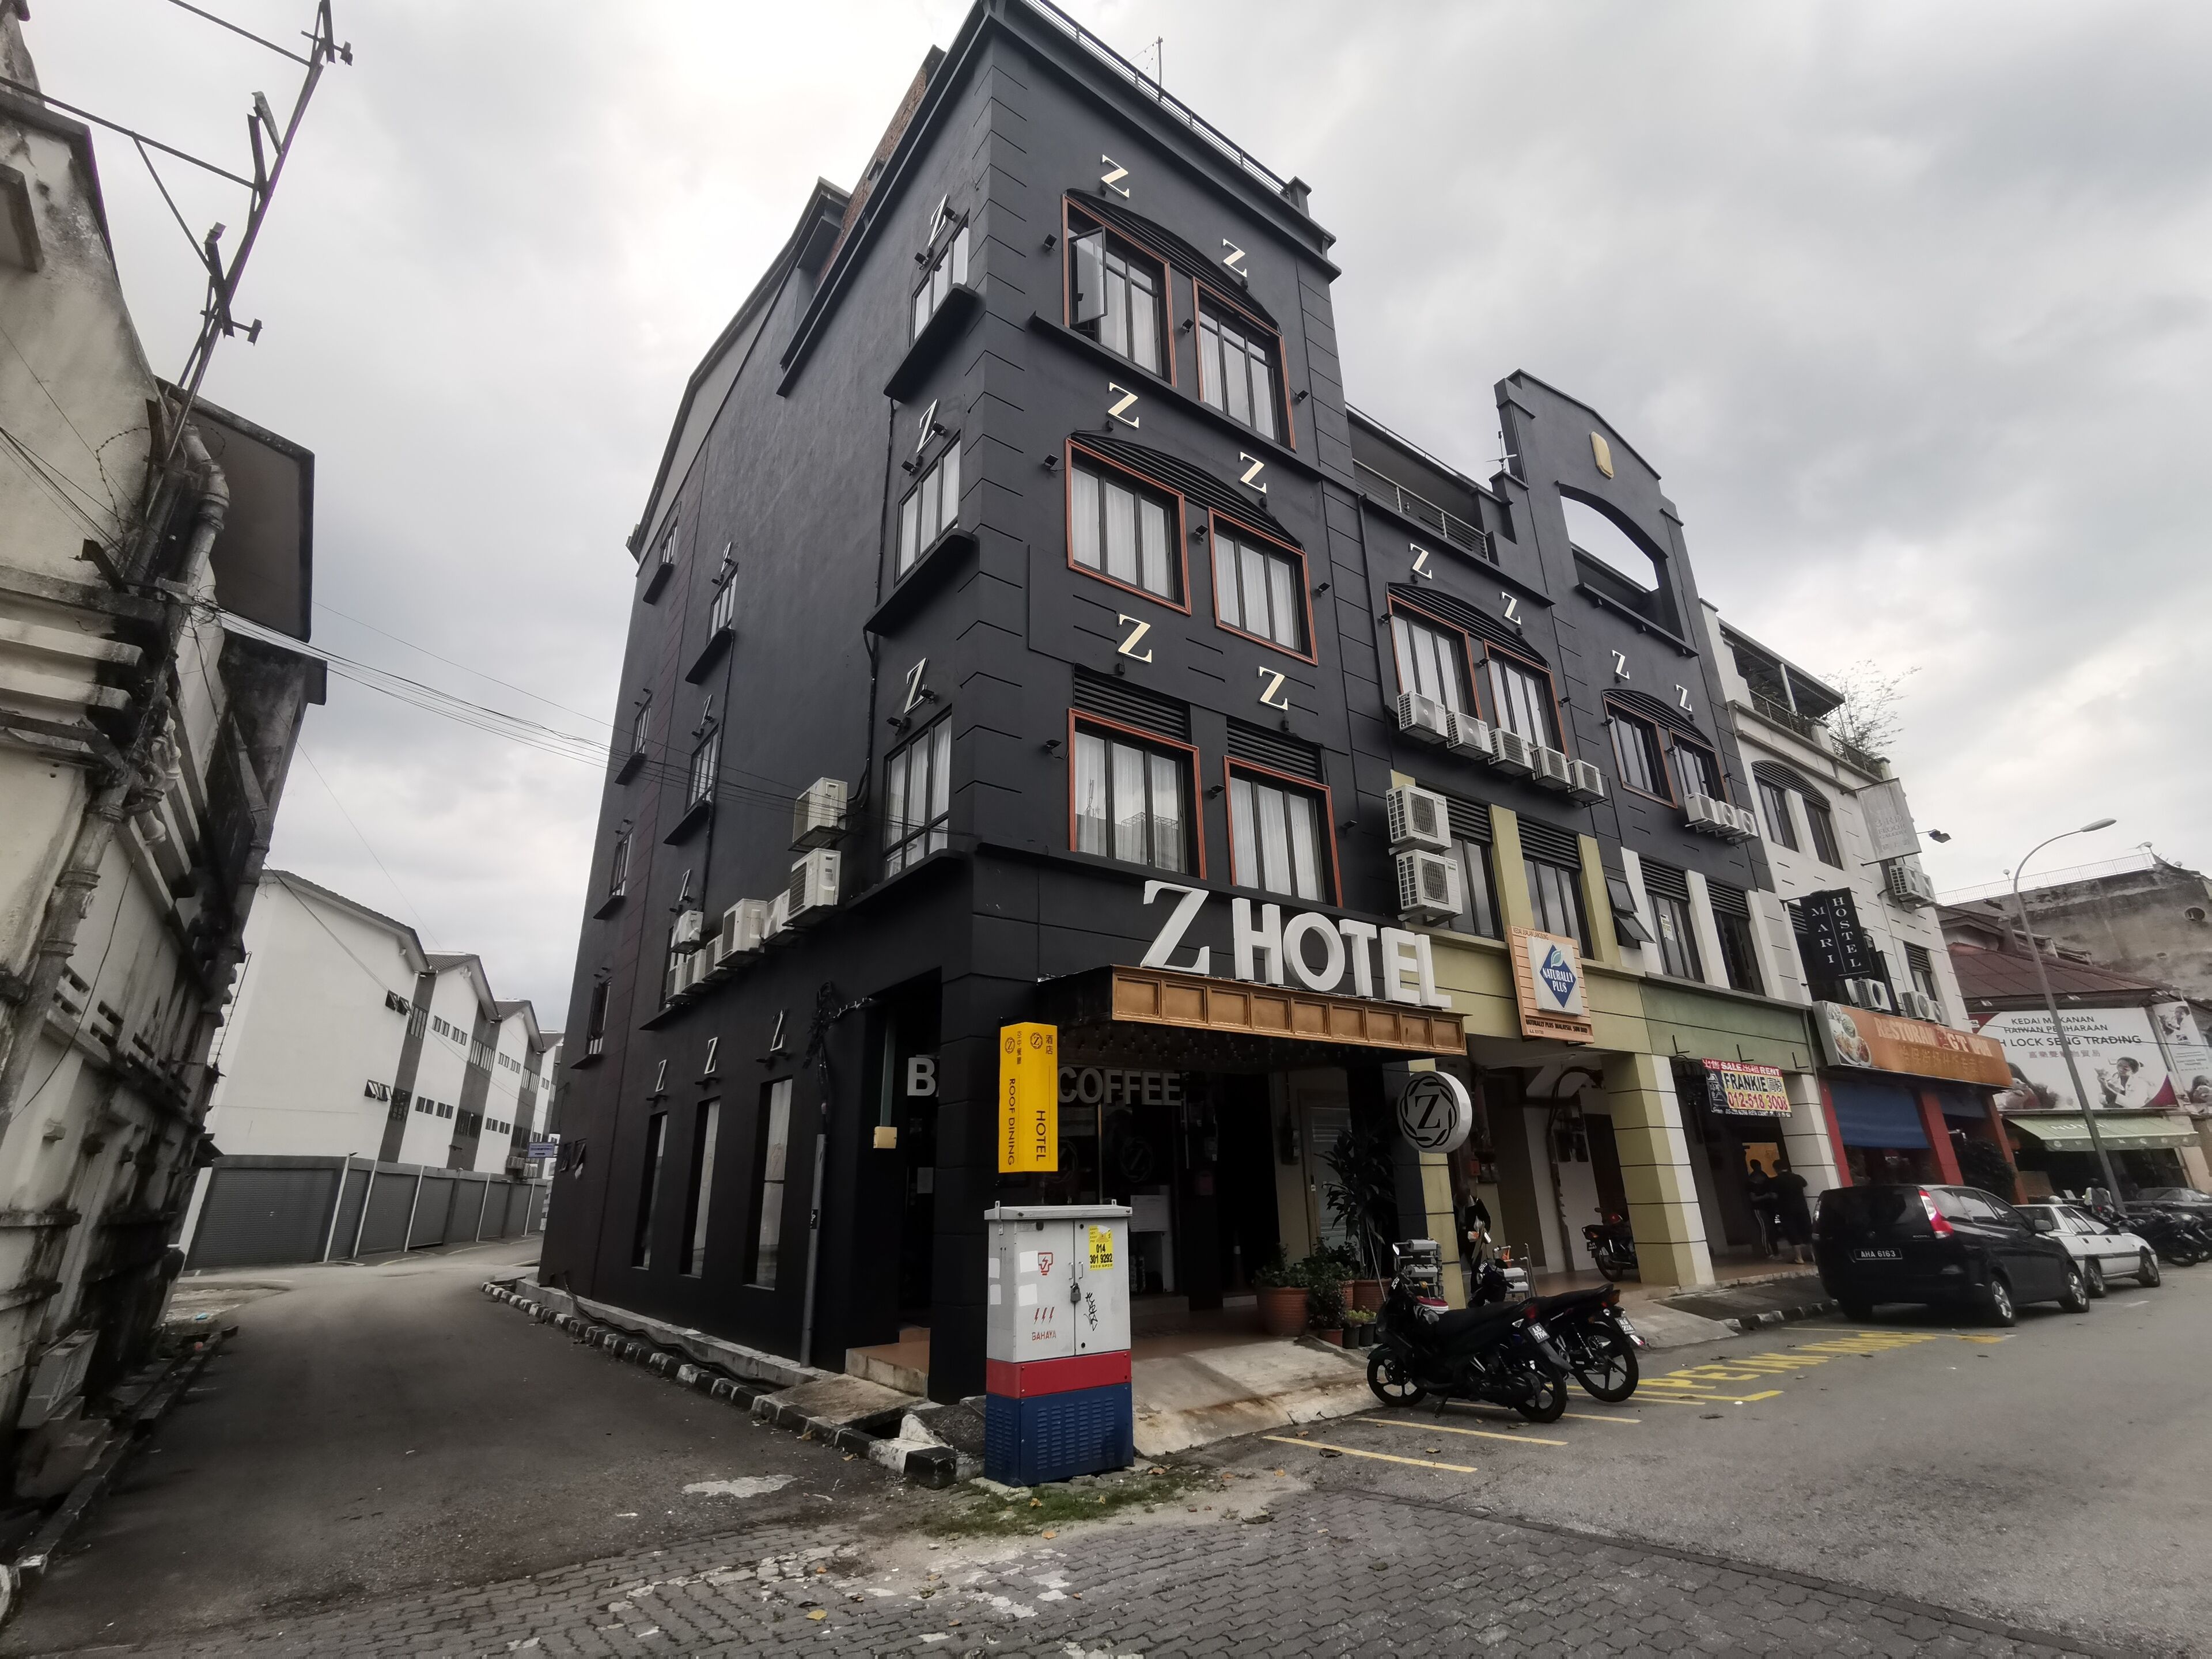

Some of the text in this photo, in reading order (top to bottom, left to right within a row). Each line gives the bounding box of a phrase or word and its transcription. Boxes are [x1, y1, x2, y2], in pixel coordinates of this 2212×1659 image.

[1101, 154, 1130, 199] Z
[1222, 238, 1248, 278] Z
[1107, 382, 1139, 429] Z
[1240, 451, 1267, 494] Z
[1410, 543, 1433, 579] Z
[1501, 591, 1522, 626] Z
[1118, 613, 1152, 663] Z
[1611, 649, 1630, 680] Z
[1259, 666, 1289, 711] Z
[1675, 683, 1693, 713] Z
[1140, 880, 1452, 1010] Z HOTEL
[1810, 906, 1835, 964] MARI
[1832, 896, 1862, 968] HOSTEL
[1542, 967, 1573, 983] NATURALLY
[1552, 980, 1567, 993] PLUS
[1873, 1017, 1937, 1047] RESTORAN
[1946, 1032, 1969, 1052] GT
[2004, 1024, 2108, 1034] HAIWAN PEIHARAAN
[2043, 1016, 2094, 1024] MKANAN
[704, 1036, 718, 1075] Z
[1046, 1035, 1053, 1055] 酒店
[2010, 1038, 2044, 1047] LOCK
[2082, 1035, 2142, 1044] TRADING
[655, 1059, 667, 1093] Z
[1058, 1066, 1182, 1107] COFFEE
[1721, 1062, 1743, 1071] SALE
[1760, 1066, 1780, 1077] RENT
[1724, 1073, 1768, 1093] FRANKIE
[1415, 1094, 1441, 1130] Z
[1728, 1091, 1789, 1111] 012-518 3008
[1036, 1110, 1046, 1162] HOTEL
[1089, 1253, 1113, 1264] 301 9292
[1096, 1243, 1106, 1253] 014
[1032, 1329, 1056, 1341] BAHAYA
[1636, 1352, 1836, 1389] PETAK
